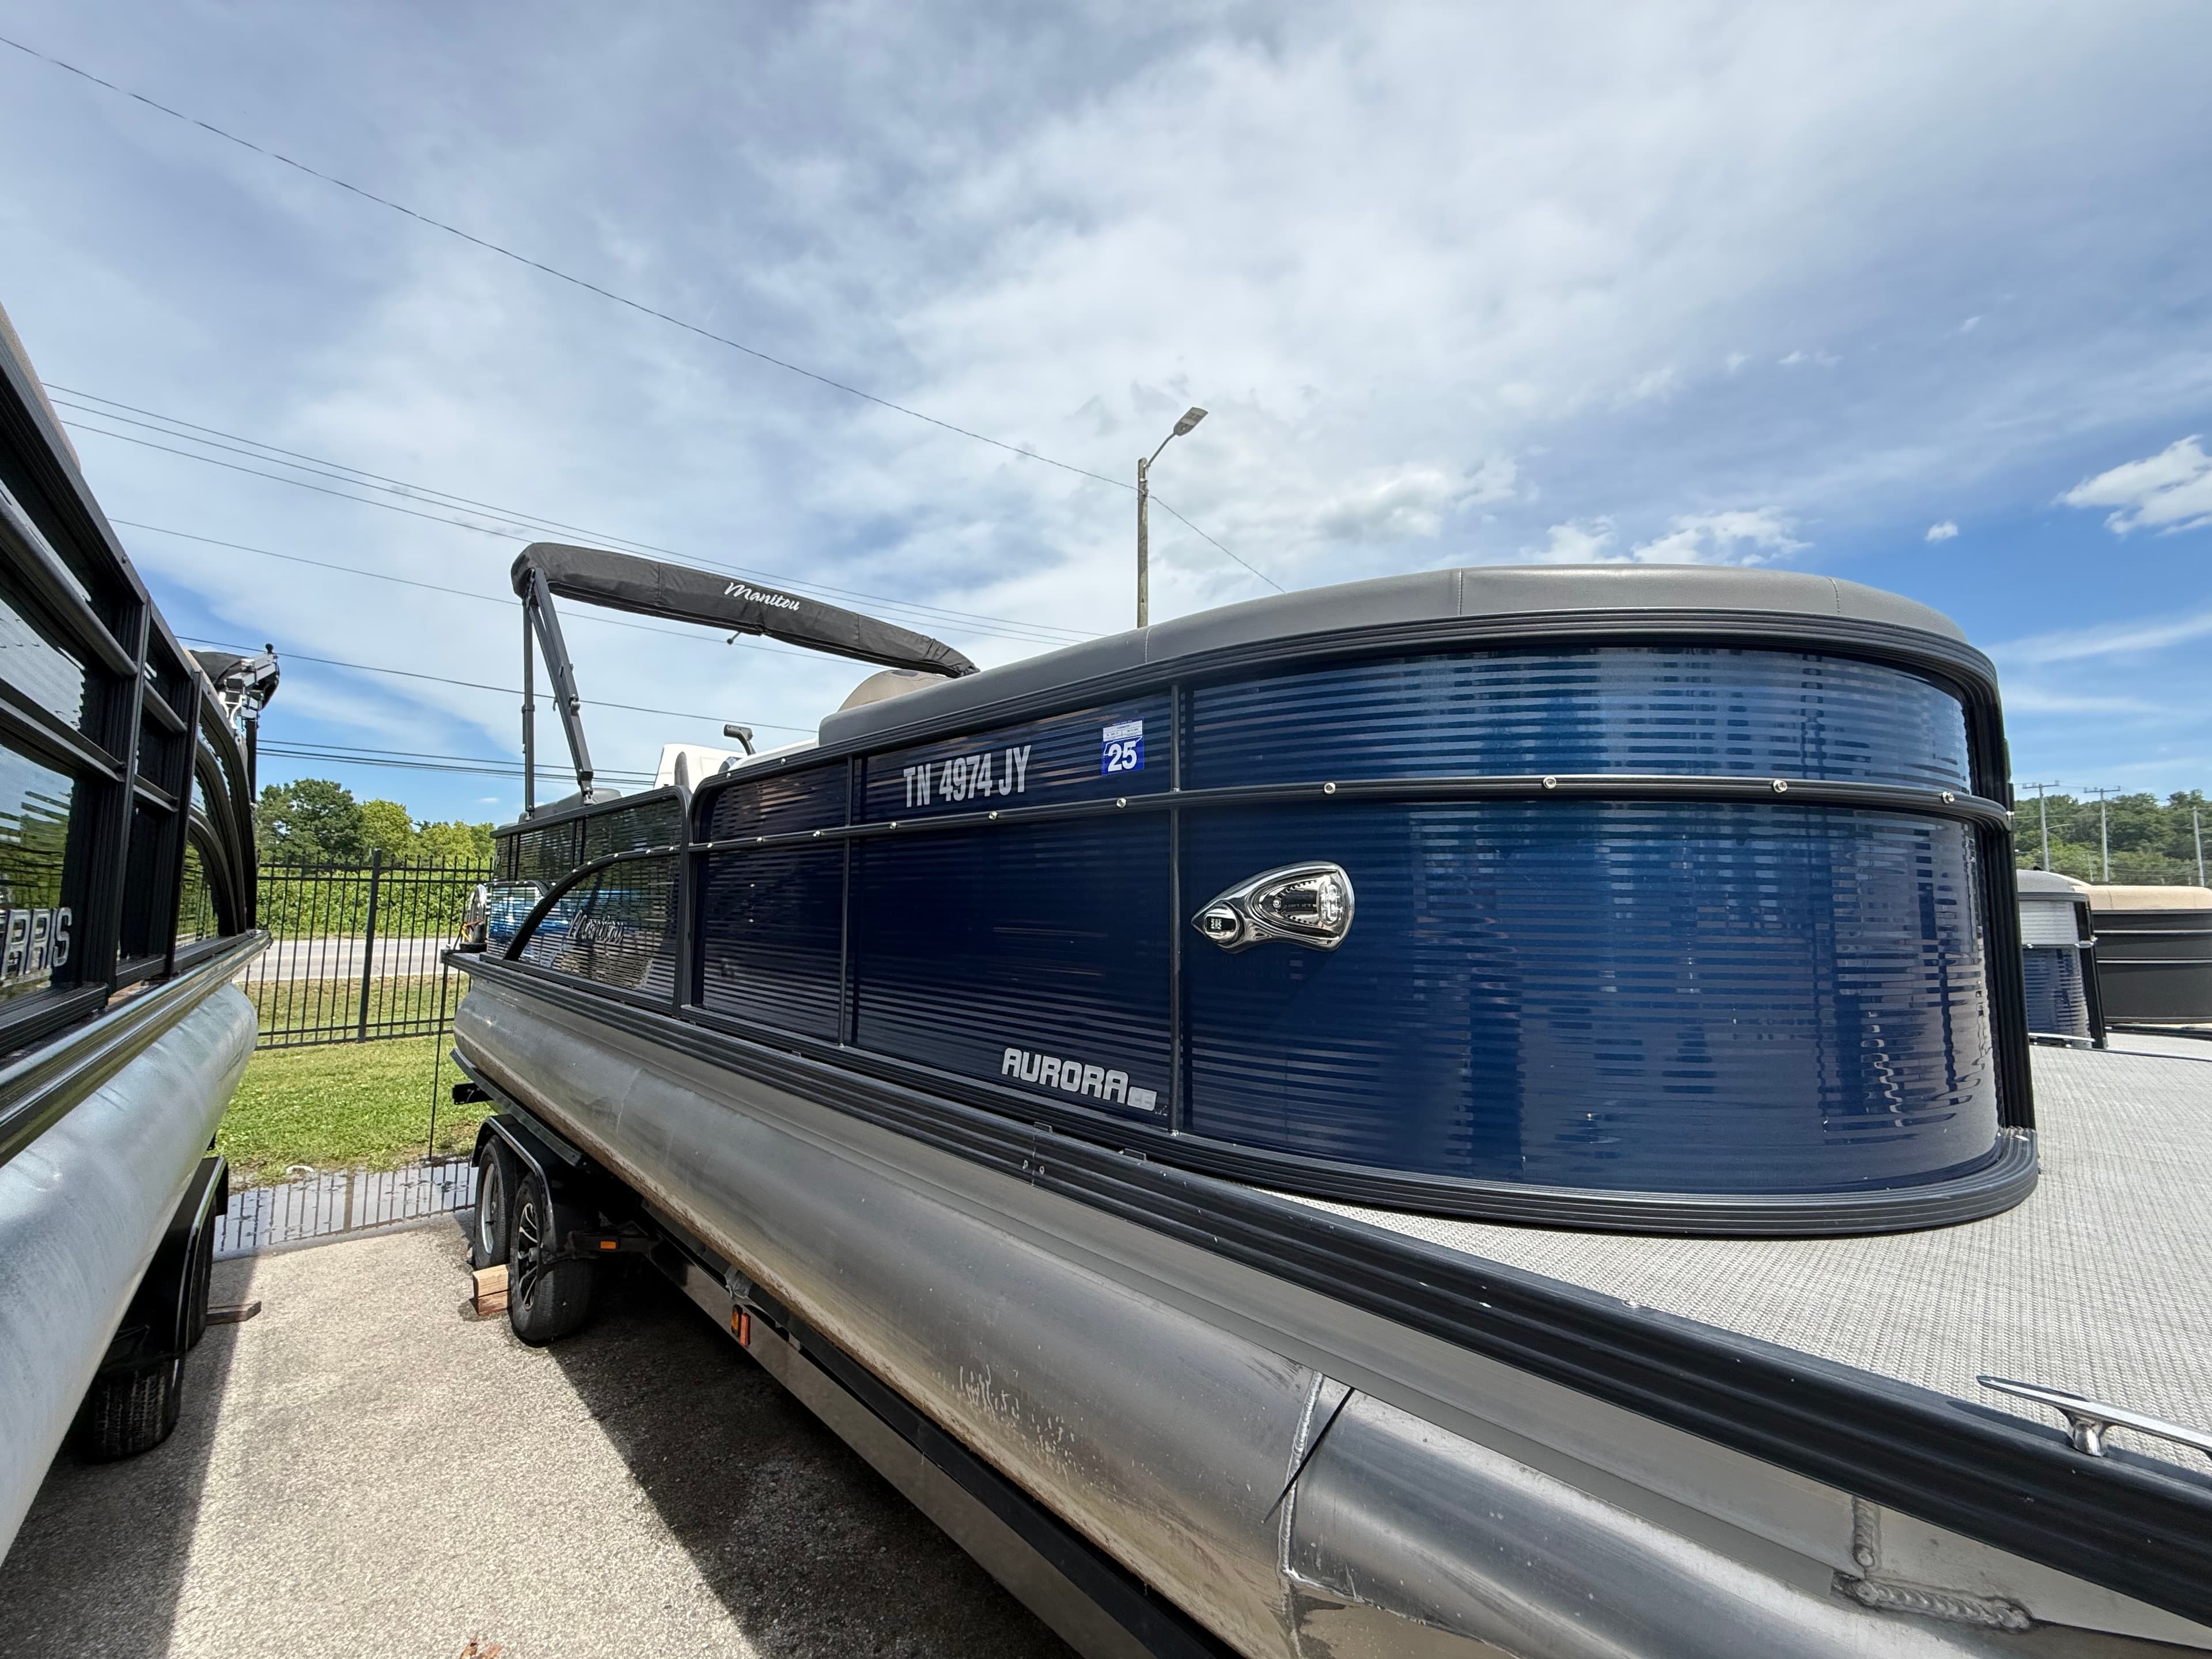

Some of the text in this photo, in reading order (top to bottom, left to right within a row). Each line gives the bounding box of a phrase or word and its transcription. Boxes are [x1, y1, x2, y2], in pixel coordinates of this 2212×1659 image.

[724, 582, 800, 611] Manitou
[903, 745, 1032, 807] TN 4974 JY
[1108, 741, 1137, 772] 25
[1001, 1047, 1129, 1104] AURORA
